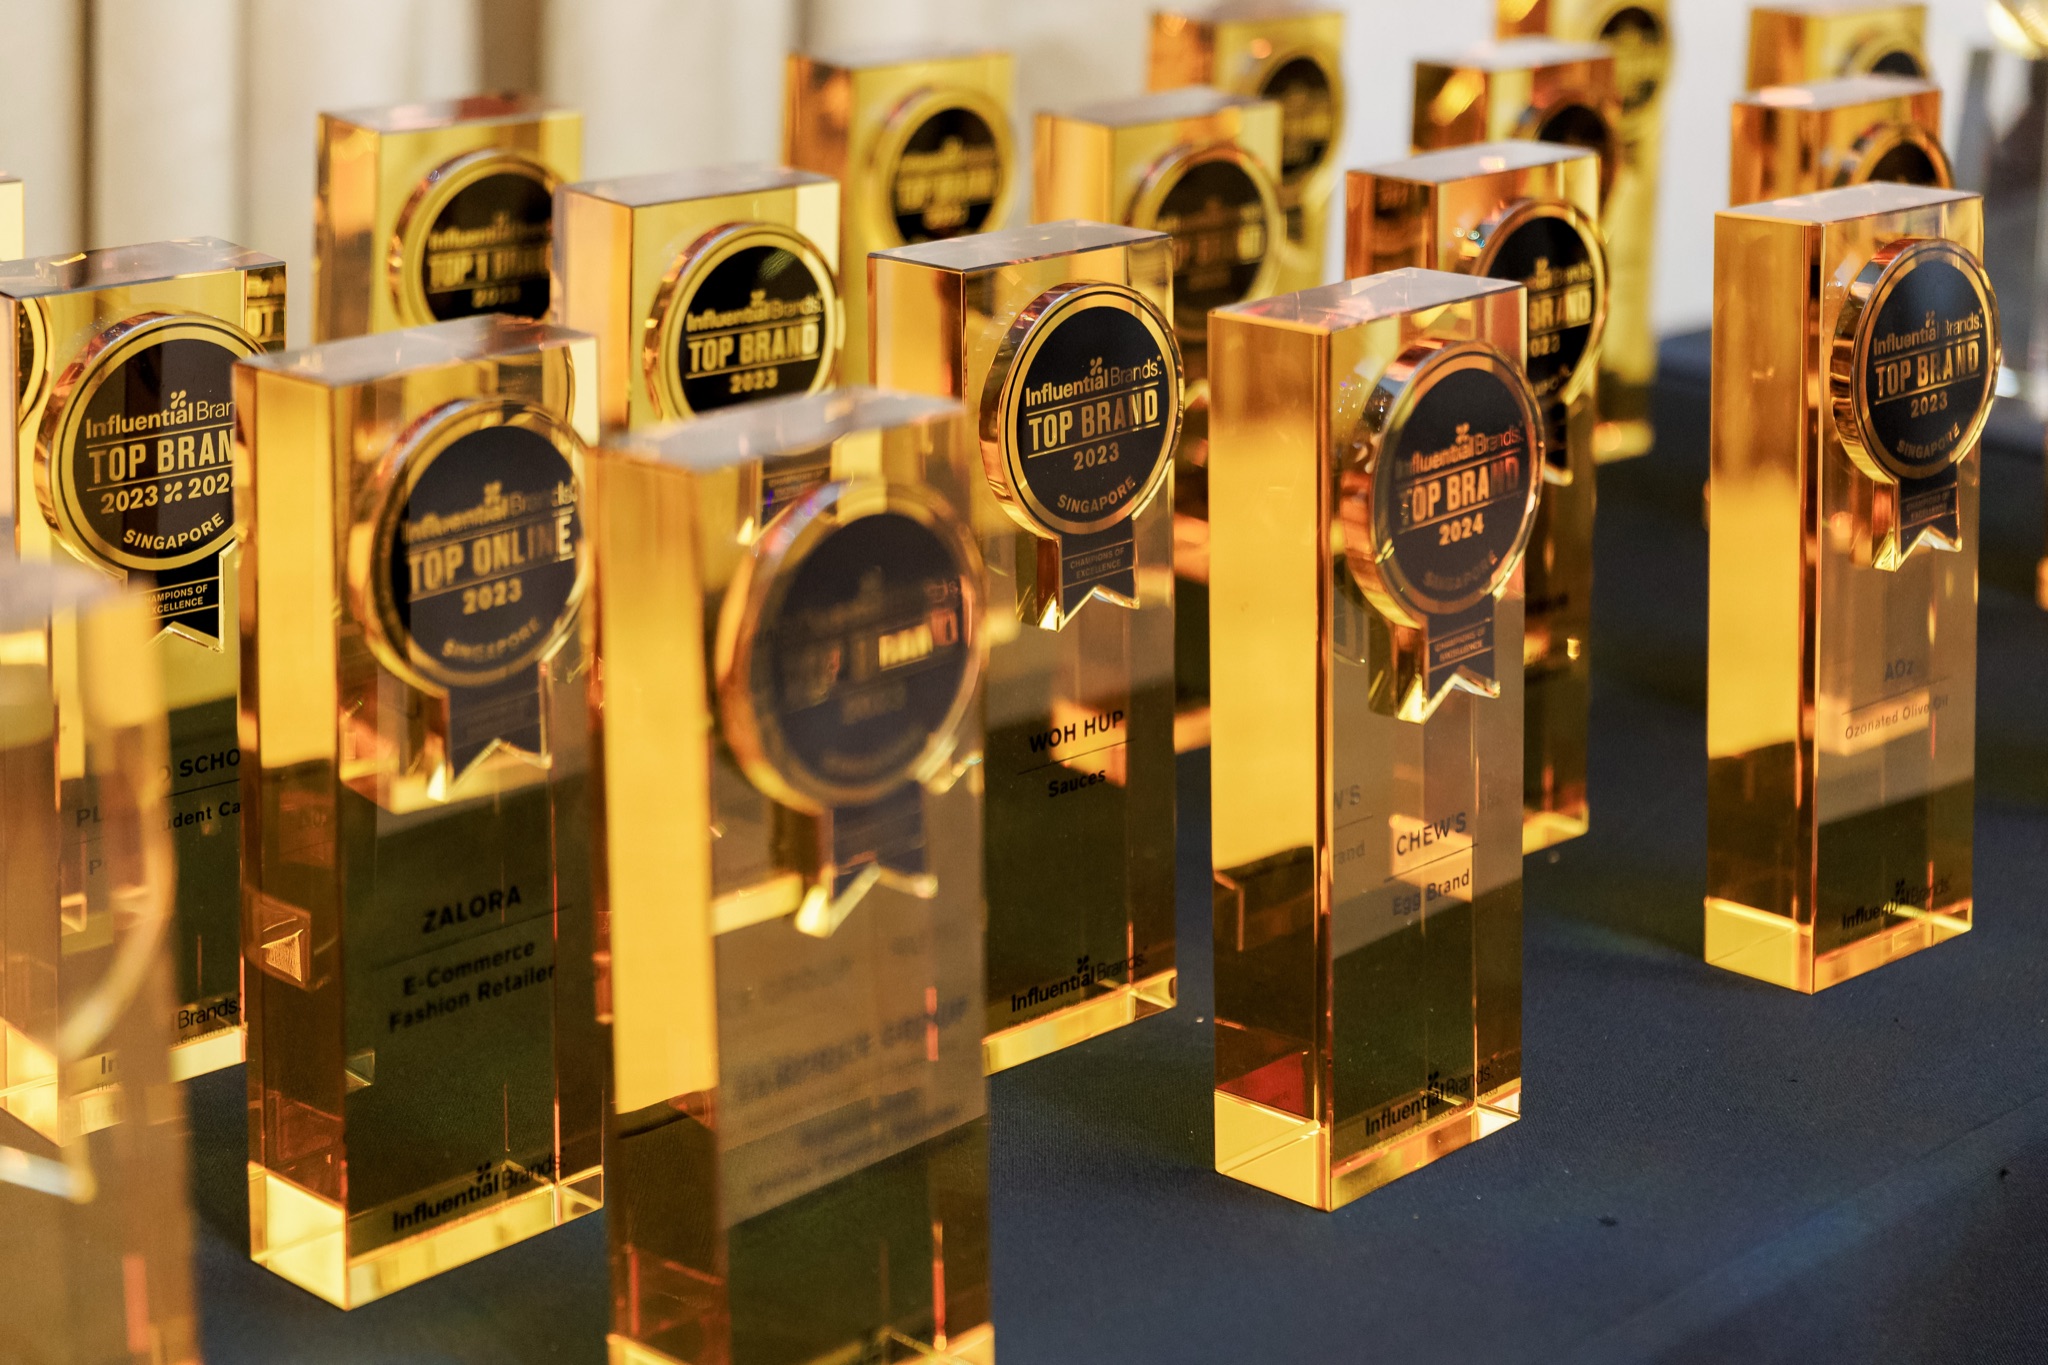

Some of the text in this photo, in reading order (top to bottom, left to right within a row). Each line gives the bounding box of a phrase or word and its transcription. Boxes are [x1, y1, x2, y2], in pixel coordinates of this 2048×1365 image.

[688, 323, 819, 373] TOP BRAND
[1875, 340, 1979, 398] TOP BRAND
[730, 367, 778, 394] 2023
[1026, 369, 1109, 407] Influential
[85, 402, 193, 439] Influential
[1029, 389, 1158, 450] TOP BRAND
[1910, 391, 1948, 418] 2023
[89, 443, 146, 484] TOP
[1073, 442, 1120, 471] 2023
[100, 472, 235, 514] 2023 202
[1057, 475, 1136, 513] SINGAPORE
[1447, 456, 1519, 512] BRAND
[123, 512, 225, 550] SINGAPORE
[1439, 512, 1484, 546] 2024
[195, 584, 208, 594] OF
[408, 543, 464, 594] TOP
[463, 577, 522, 615] 2023
[1029, 710, 1124, 753] WOH HUP
[1845, 712, 1898, 740] Ozonated
[1902, 703, 1929, 721] Olive
[180, 748, 240, 777] SCHO
[1048, 770, 1106, 798] Sauces
[1396, 811, 1466, 856] CHEW'S
[422, 885, 522, 933] ZALORA
[1393, 868, 1470, 916] Egg Brand
[403, 941, 536, 996] E-Commerce
[1011, 967, 1095, 1012] Influential
[389, 964, 555, 1033] Fashion Retailer
[1365, 1083, 1444, 1136] Influential
[393, 1174, 499, 1233] Influential
